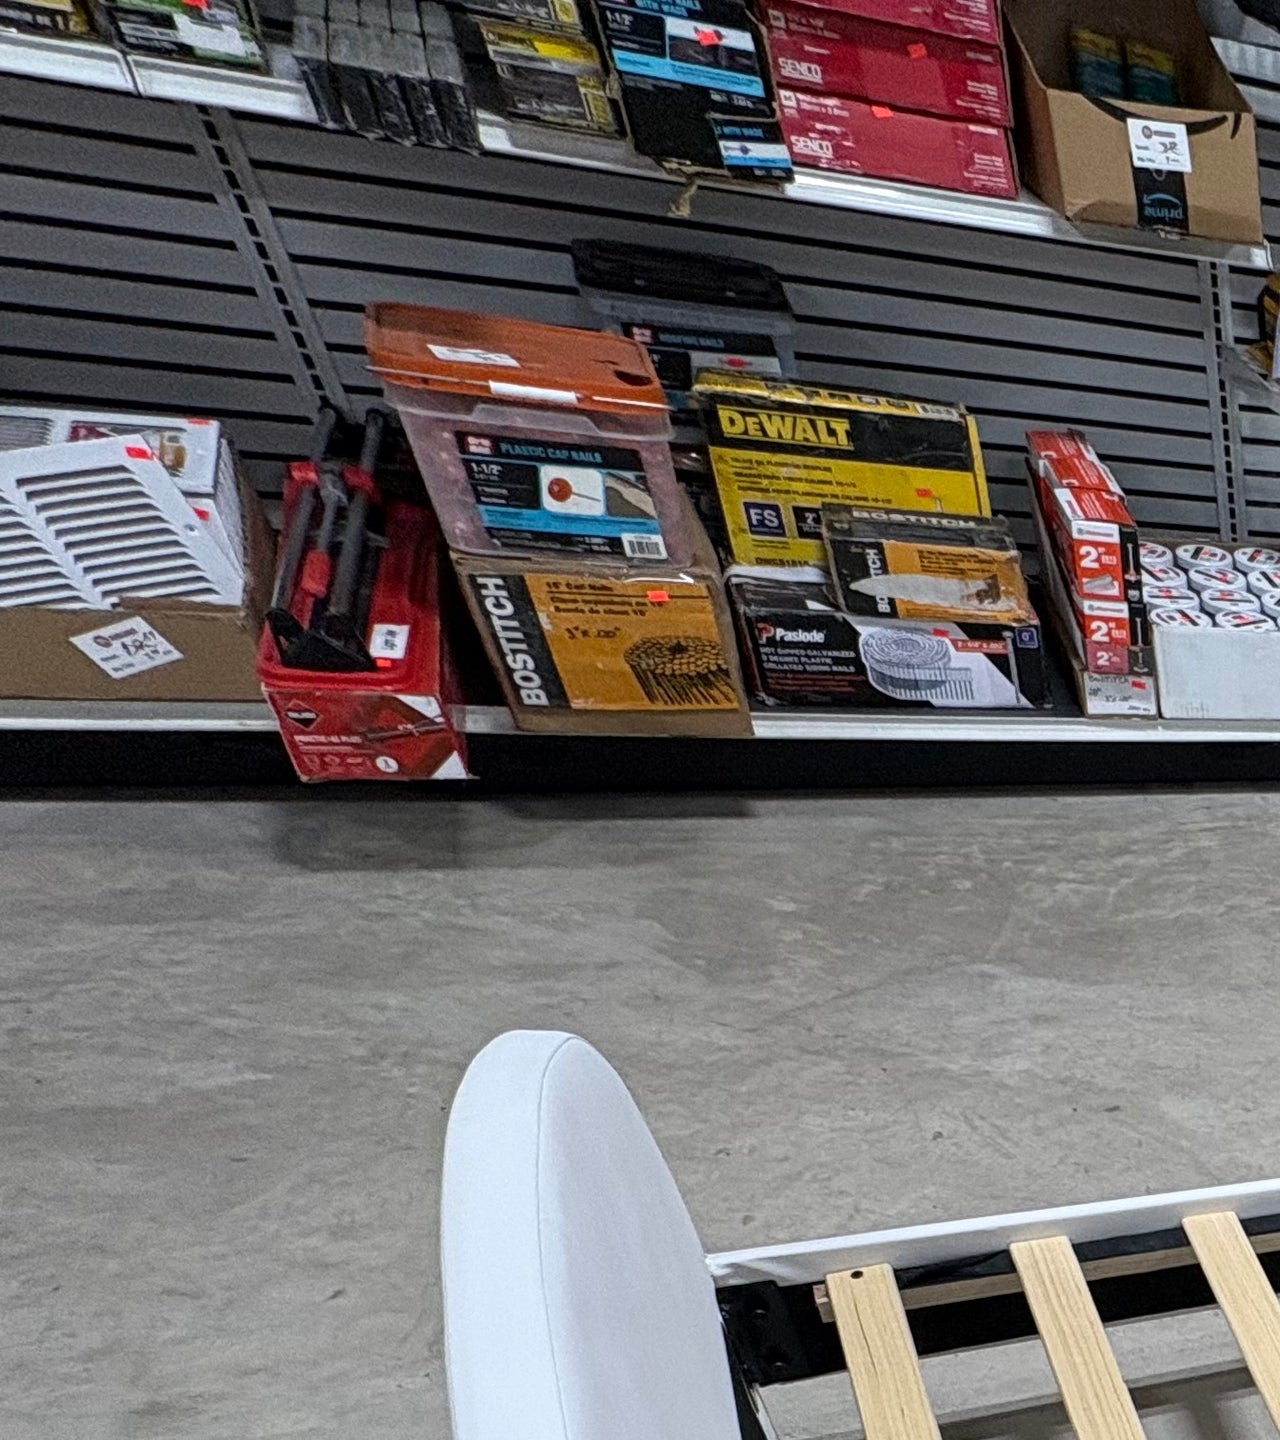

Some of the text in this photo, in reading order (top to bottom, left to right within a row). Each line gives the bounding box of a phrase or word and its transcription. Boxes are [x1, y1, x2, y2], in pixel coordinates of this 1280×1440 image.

[778, 57, 823, 84] SENCO
[790, 134, 834, 158] SENCO
[720, 408, 851, 447] DEWALT
[548, 446, 571, 461] CAP
[750, 509, 779, 528] FS
[852, 510, 977, 528] BOSTITCH
[476, 576, 549, 707] BOSTITCH
[775, 627, 827, 644] Paslode
